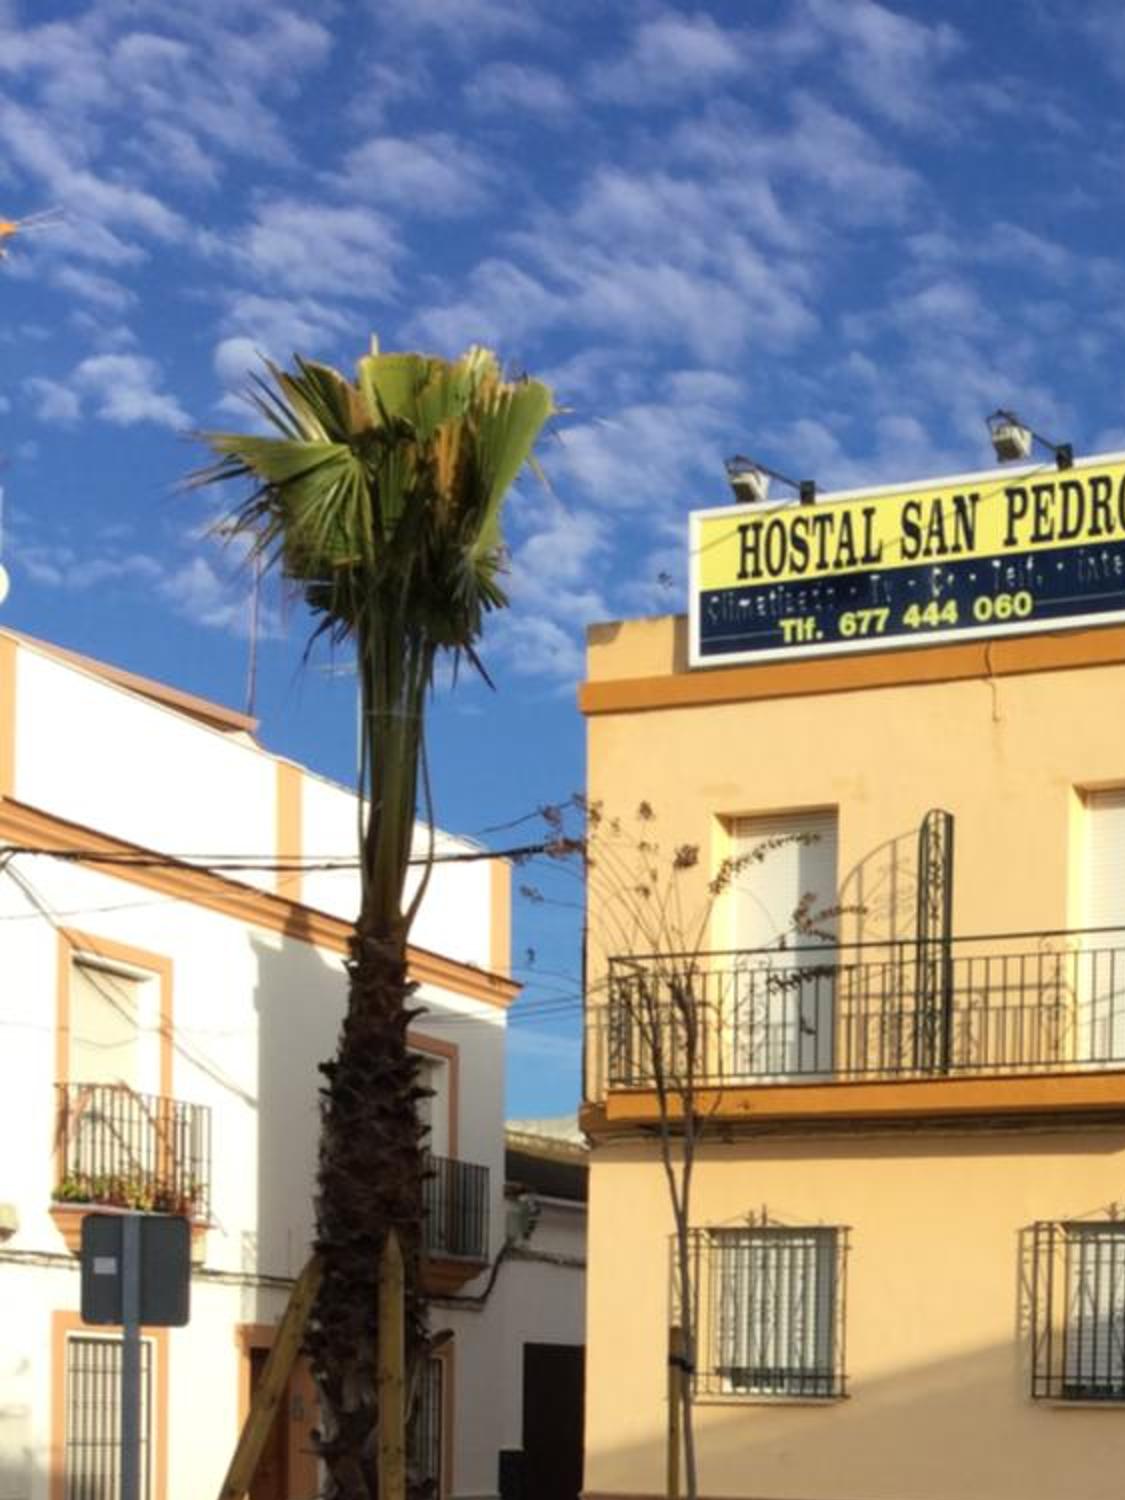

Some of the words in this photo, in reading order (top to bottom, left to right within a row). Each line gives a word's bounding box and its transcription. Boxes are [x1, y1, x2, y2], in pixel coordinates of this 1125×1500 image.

[736, 507, 882, 580] HOSTAL
[900, 494, 980, 560] SAN
[779, 616, 823, 643] Tlf.
[839, 607, 890, 636] 677
[903, 599, 958, 628] 444
[973, 591, 1033, 622] 060
